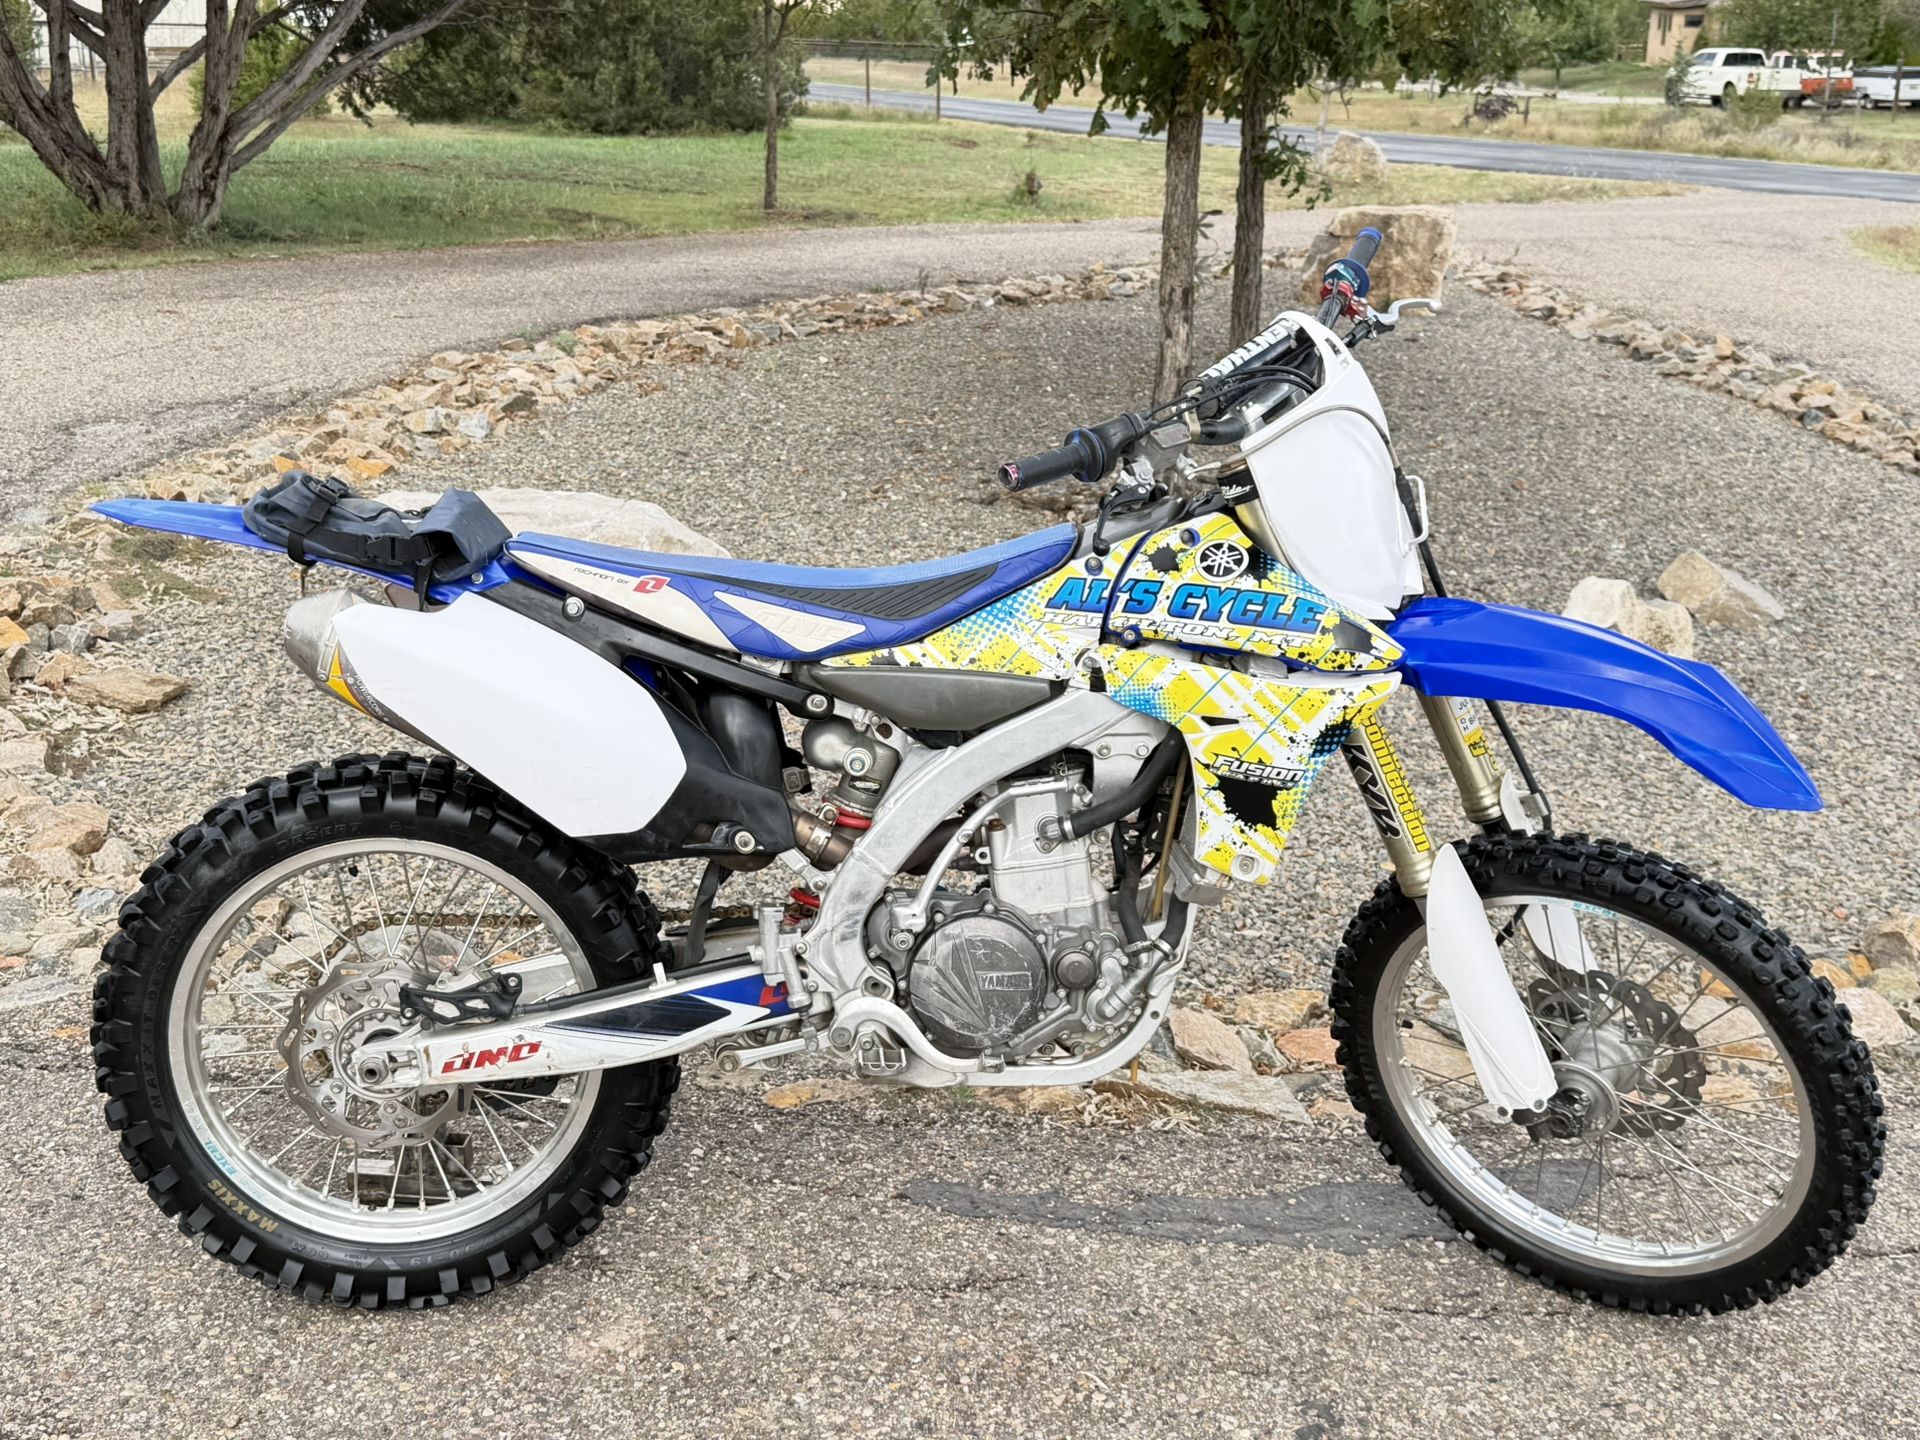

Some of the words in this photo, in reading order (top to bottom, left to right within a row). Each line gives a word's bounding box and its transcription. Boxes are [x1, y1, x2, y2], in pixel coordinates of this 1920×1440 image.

[1199, 318, 1300, 379] RENTHAL
[1045, 577, 1164, 614] AL'S
[1167, 583, 1329, 634] CYCLE
[1248, 630, 1316, 647] MT
[1212, 754, 1306, 782] FUSION
[207, 1179, 279, 1233] MAXXIS
